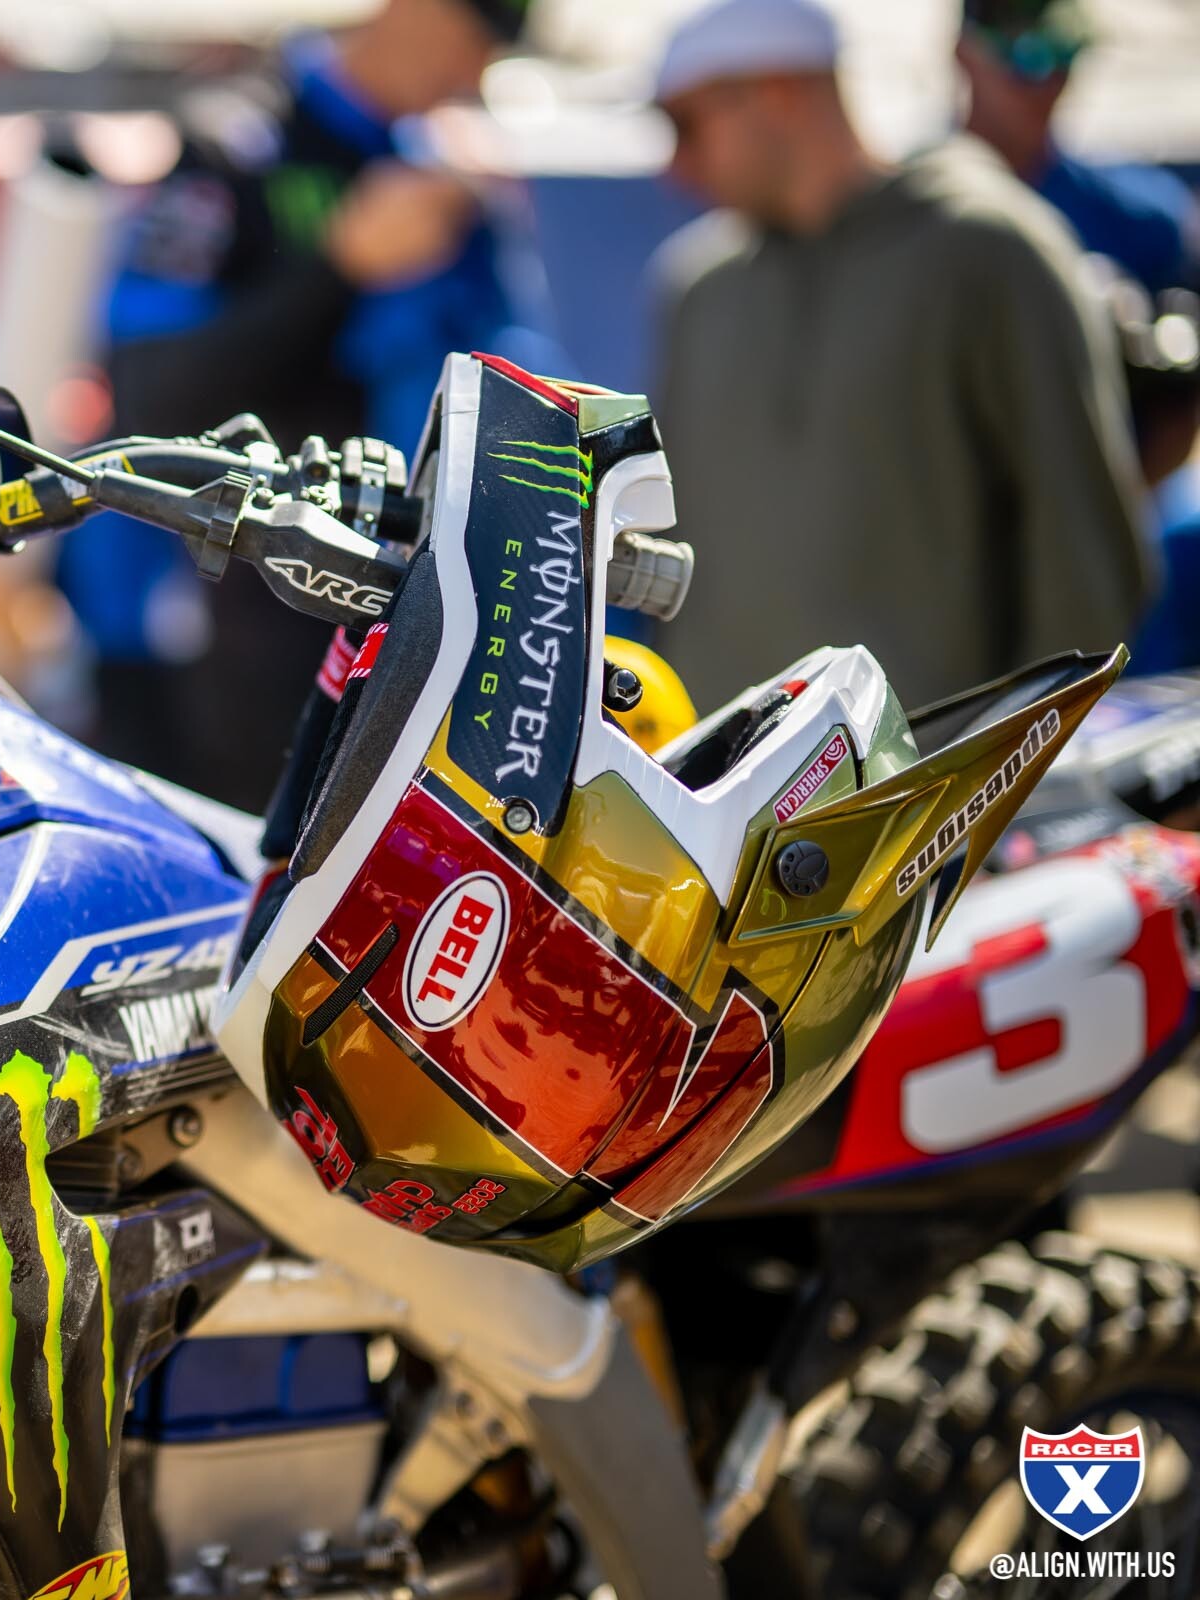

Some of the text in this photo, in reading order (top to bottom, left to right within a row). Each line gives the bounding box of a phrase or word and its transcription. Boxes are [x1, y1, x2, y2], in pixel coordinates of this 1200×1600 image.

[474, 539, 523, 731] ENERGY
[776, 760, 829, 817] SPHERICAL
[417, 895, 494, 1003] BELL
[900, 855, 1147, 1154] 3
[452, 1178, 505, 1216] 2022
